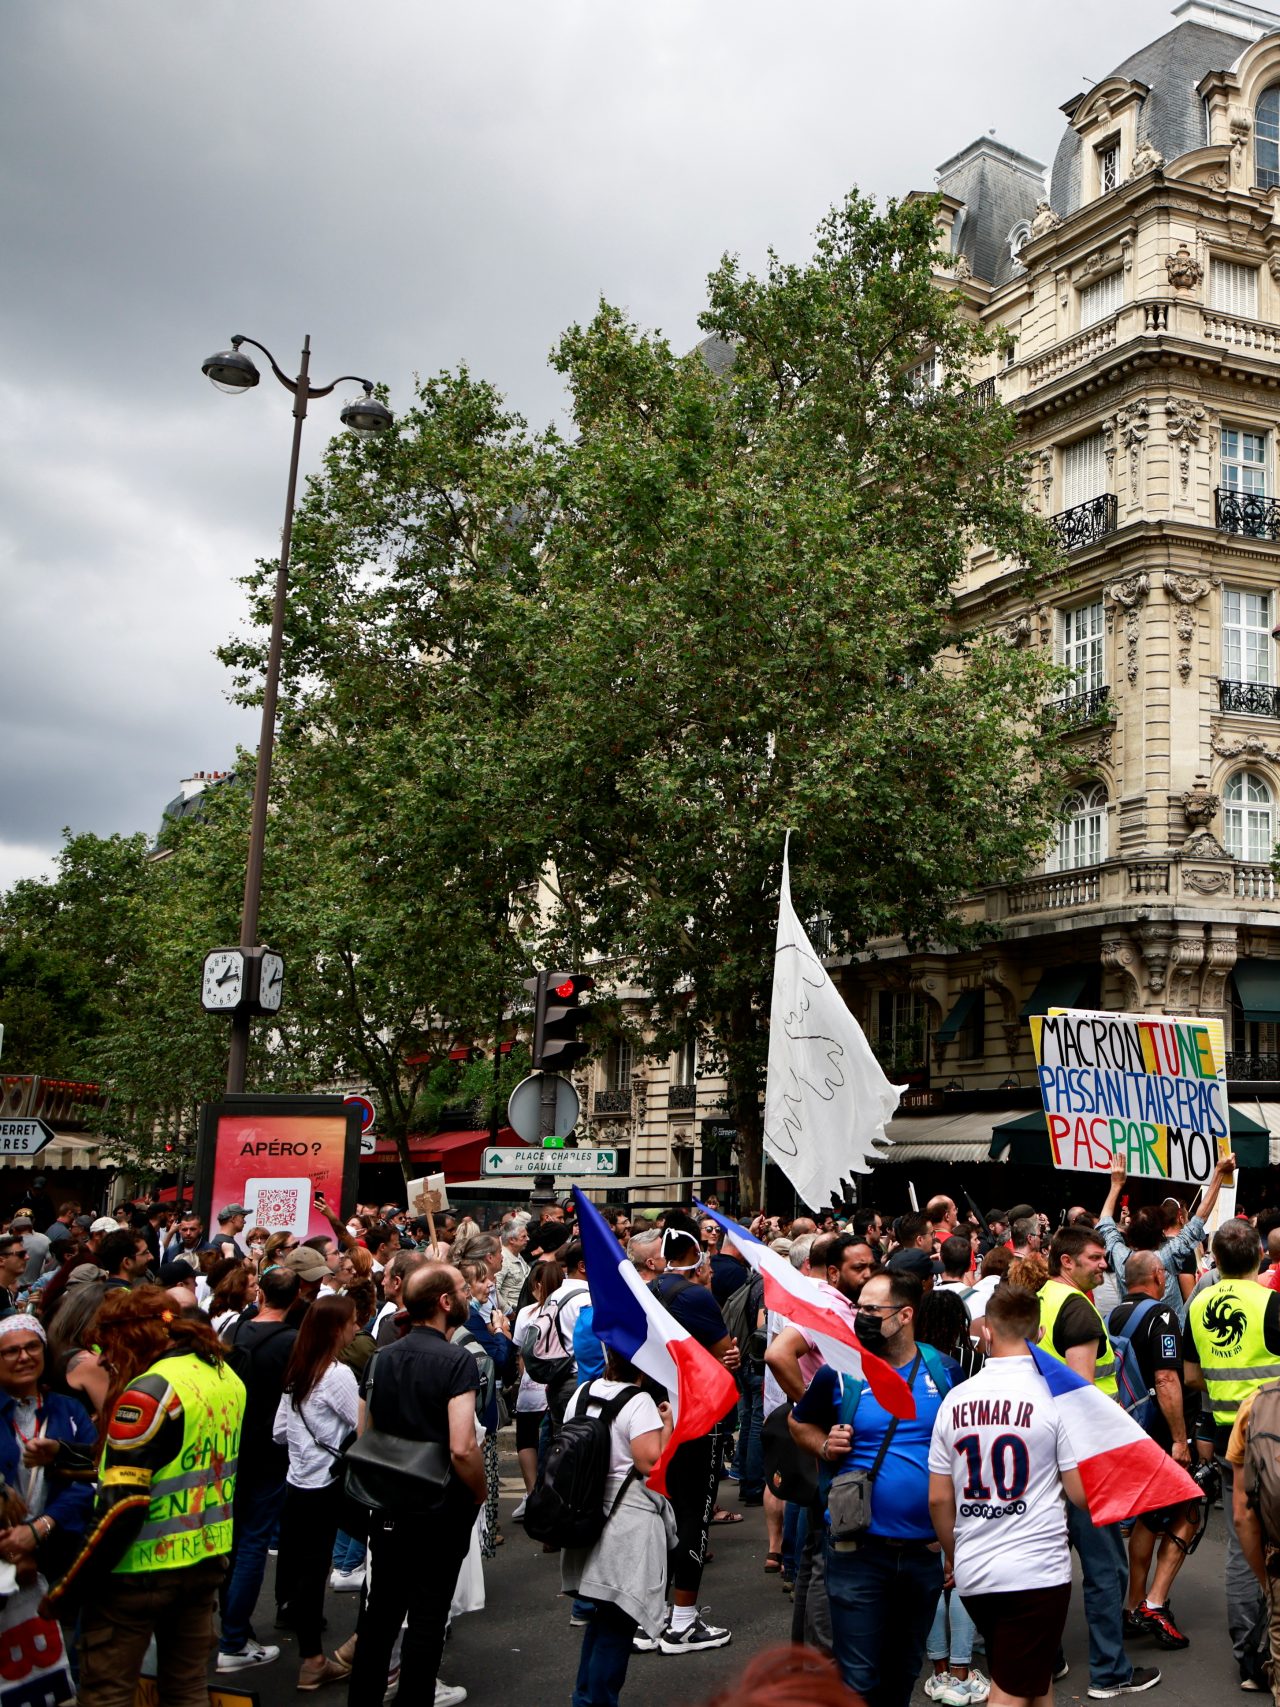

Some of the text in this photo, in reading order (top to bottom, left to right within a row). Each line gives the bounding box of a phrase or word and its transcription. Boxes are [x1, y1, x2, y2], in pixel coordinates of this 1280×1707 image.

[1041, 1017, 1147, 1073] MACRON
[0, 1124, 37, 1136] ERRET
[240, 1139, 322, 1156] APÉRO ?
[550, 1138, 557, 1147] 5
[1048, 1115, 1112, 1170] PAS
[1109, 1118, 1167, 1178] PAR
[515, 1151, 545, 1161] PLACE
[527, 1162, 563, 1171] GAULLE
[952, 1400, 1034, 1431] NEYMAR JR
[953, 1433, 1030, 1501] 10
[148, 1488, 188, 1521] EN
